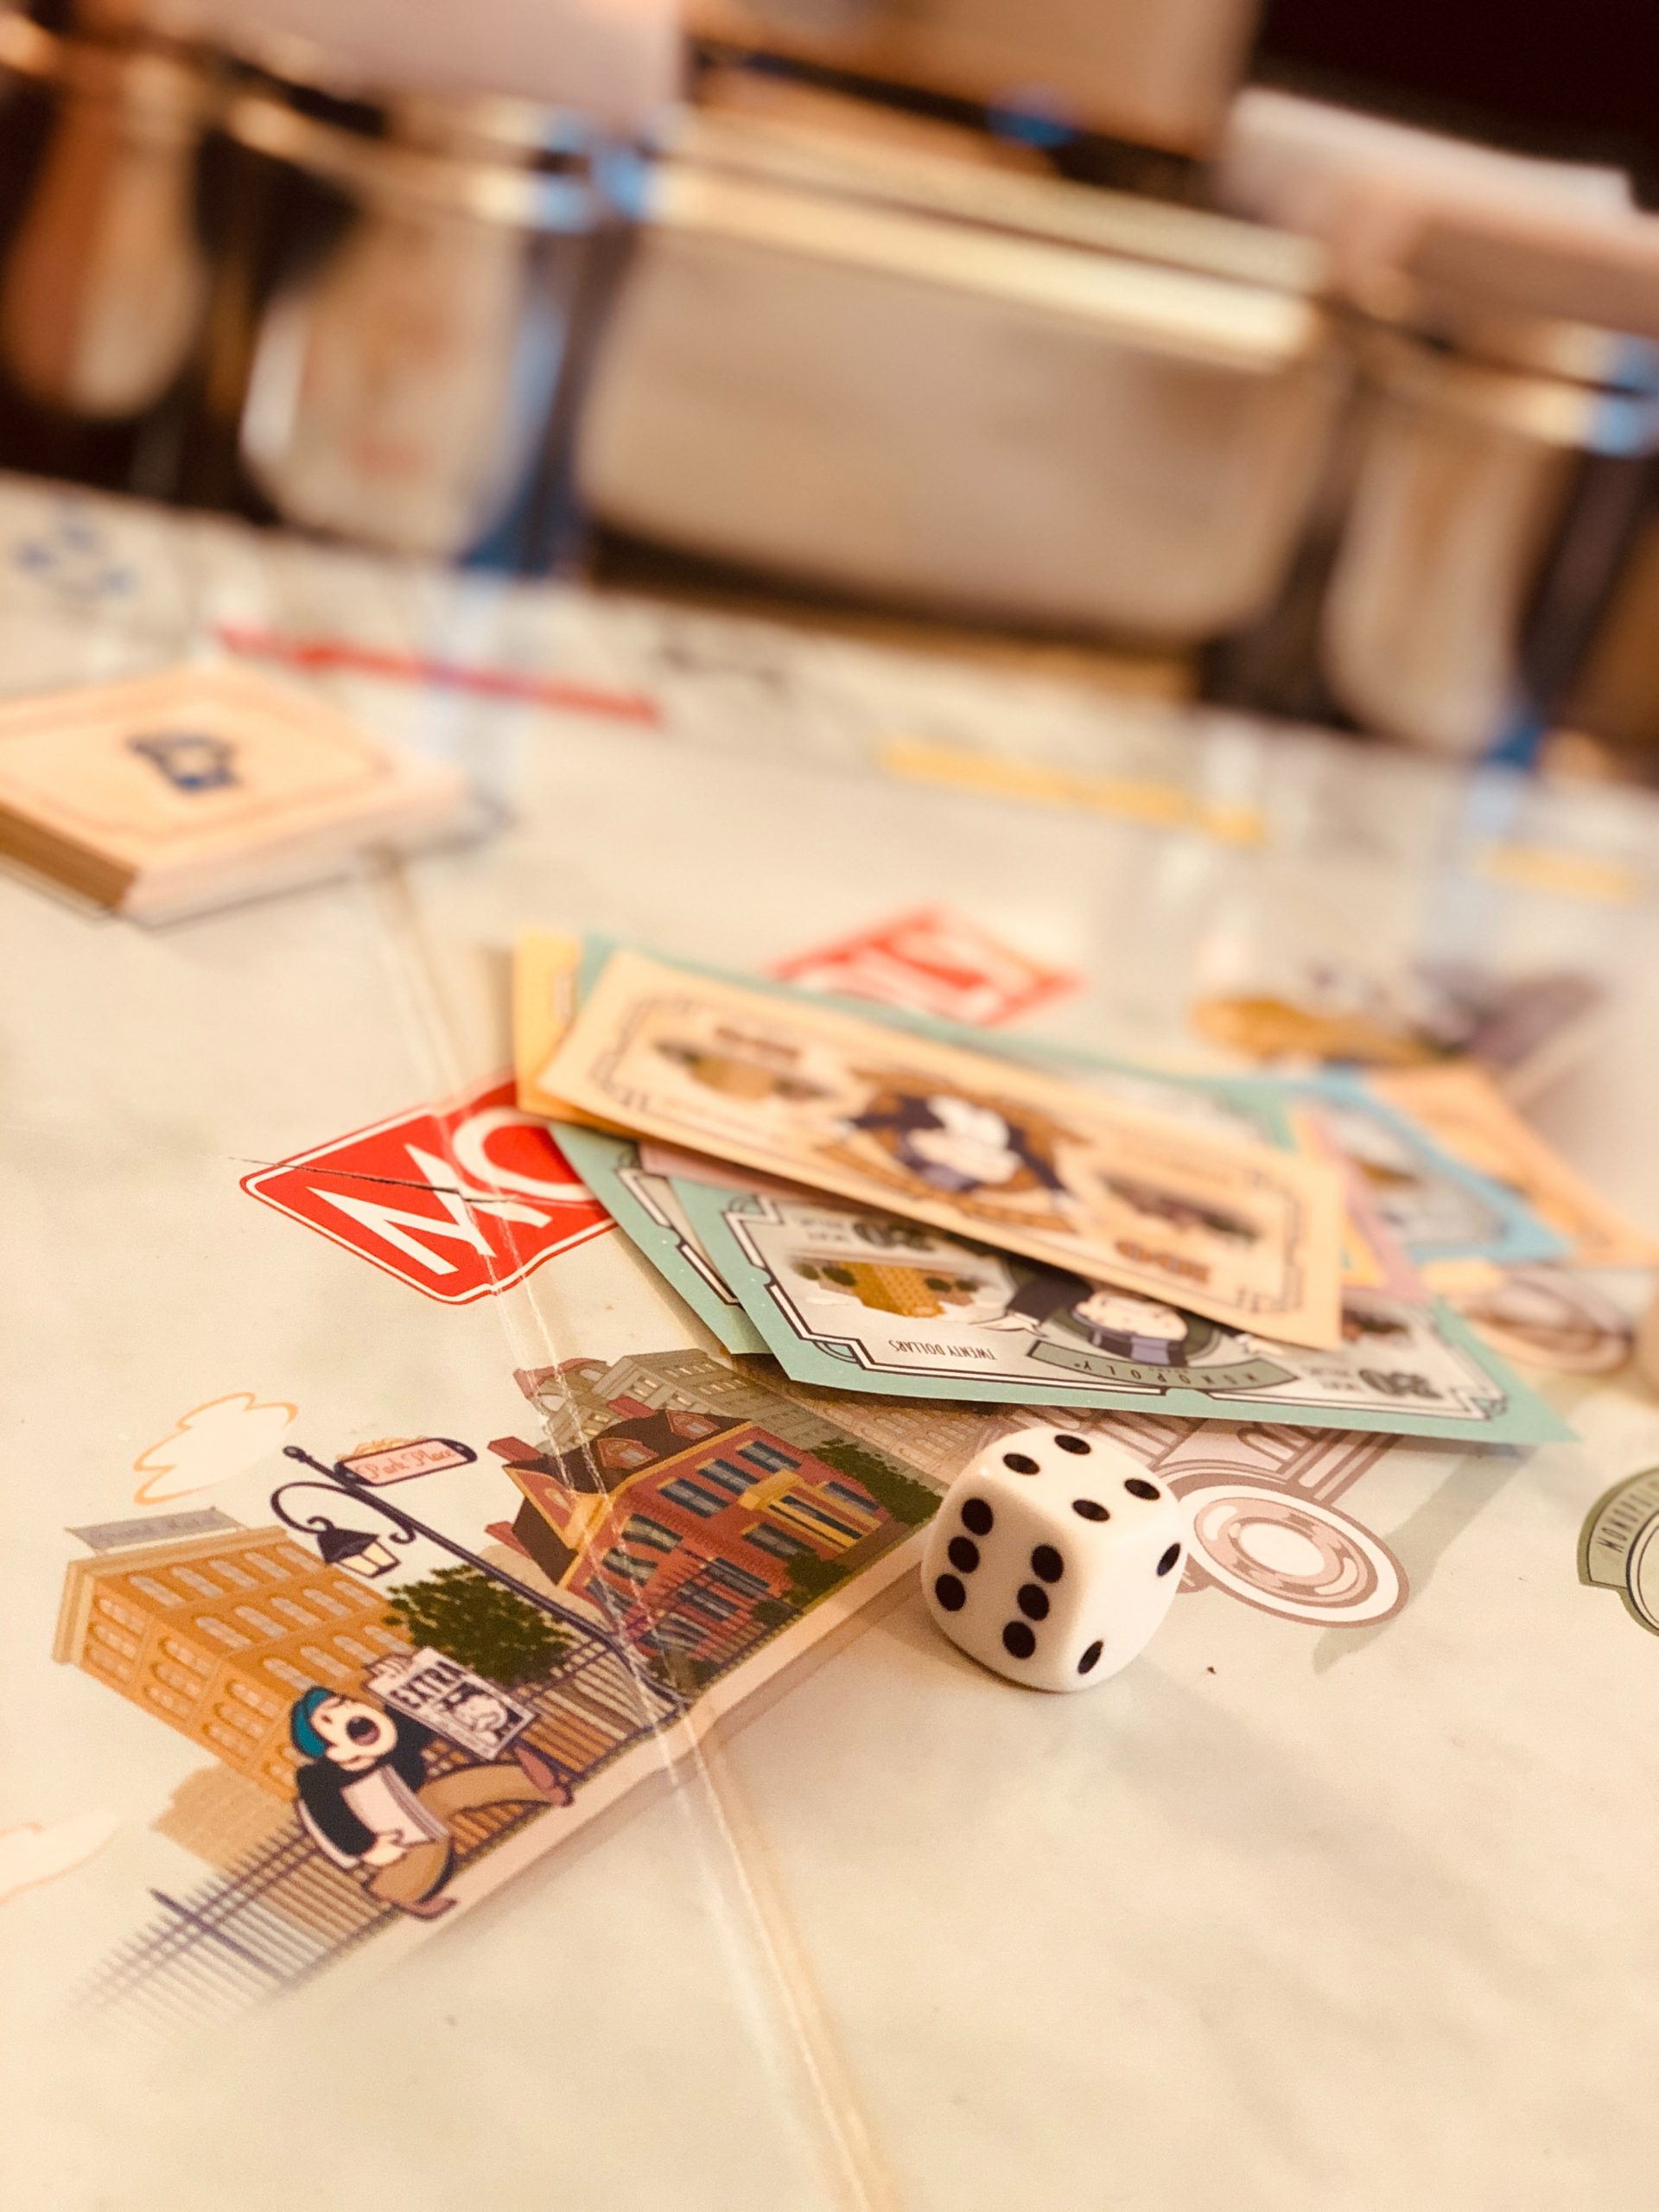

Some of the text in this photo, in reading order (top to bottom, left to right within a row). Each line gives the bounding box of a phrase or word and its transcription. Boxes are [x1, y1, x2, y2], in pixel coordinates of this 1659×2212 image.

[887, 1339, 997, 1361] TWENTY DOLLARS
[355, 1449, 454, 1479] Park Place
